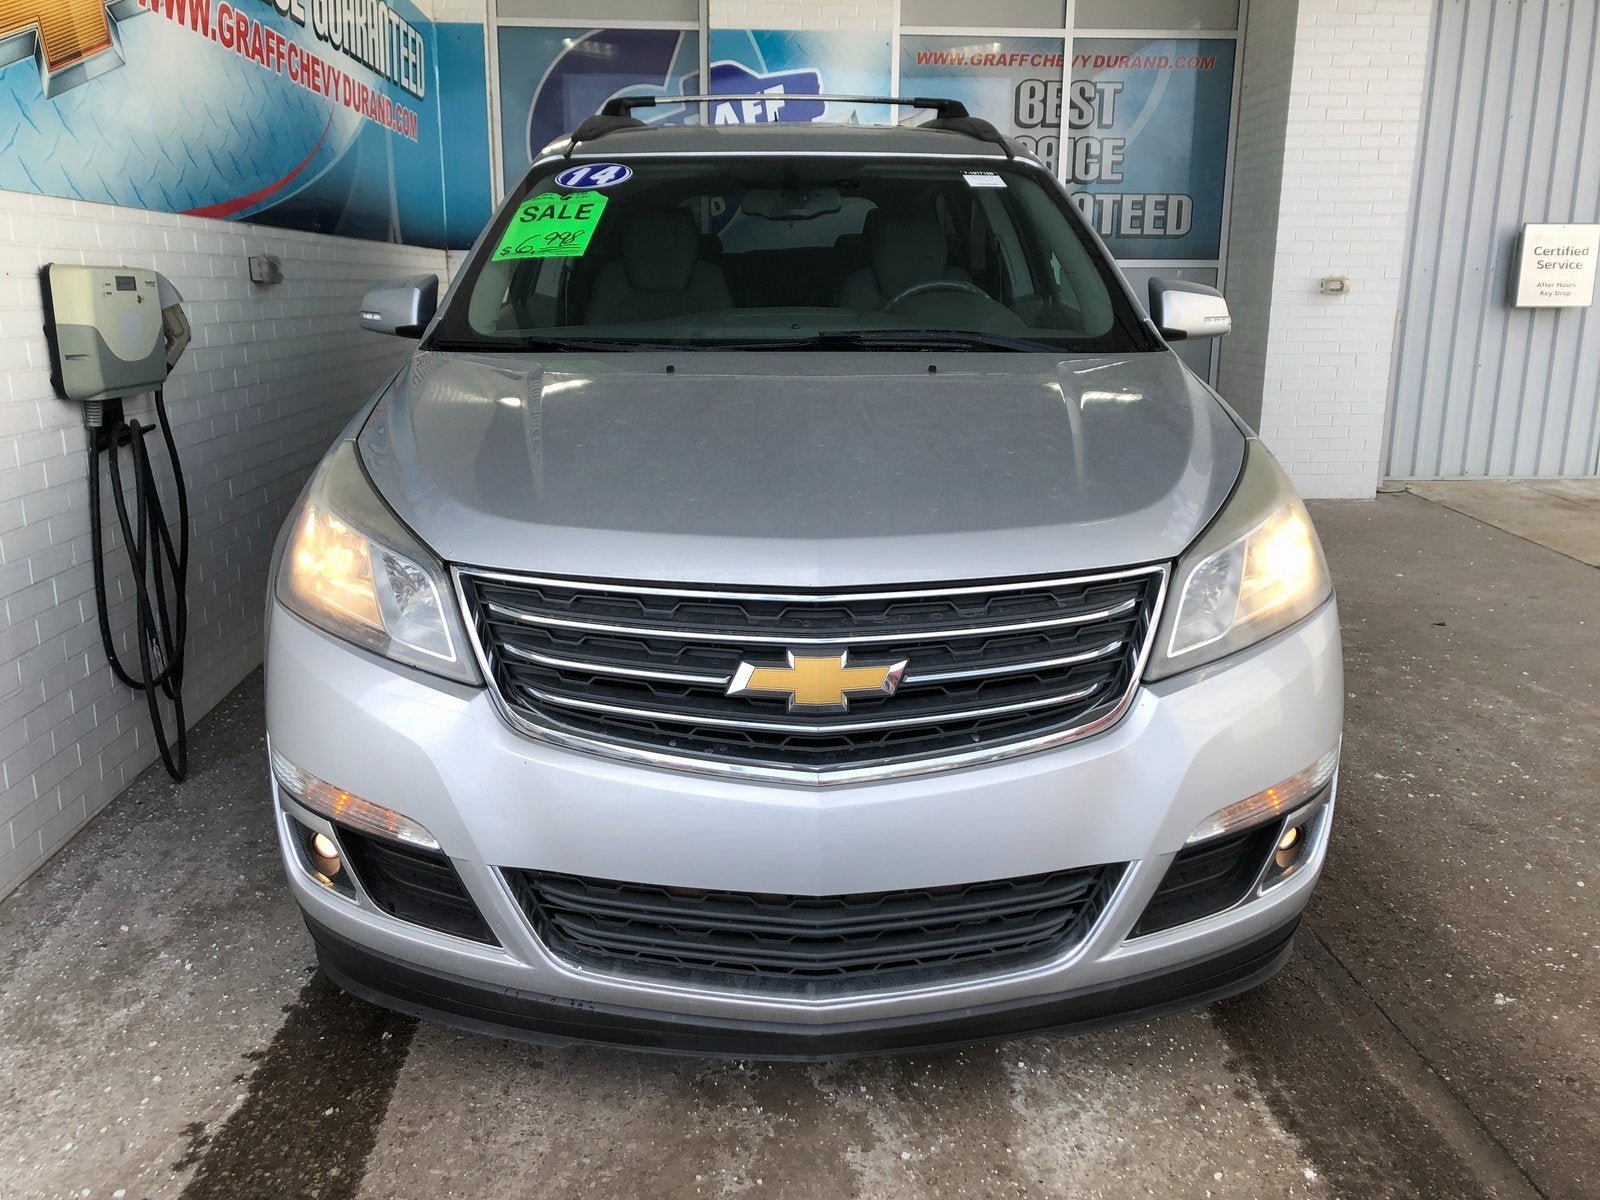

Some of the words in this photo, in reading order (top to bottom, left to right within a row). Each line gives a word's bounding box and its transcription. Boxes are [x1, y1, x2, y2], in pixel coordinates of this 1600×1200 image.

[137, 0, 419, 142] W.GRAFFCHEVYDURAND.COM
[714, 84, 786, 124] AFF
[1014, 79, 1124, 129] BEST
[566, 165, 622, 186] 14
[520, 203, 595, 223] SALE
[1533, 246, 1590, 256] Certified
[1536, 260, 1583, 270] Service
